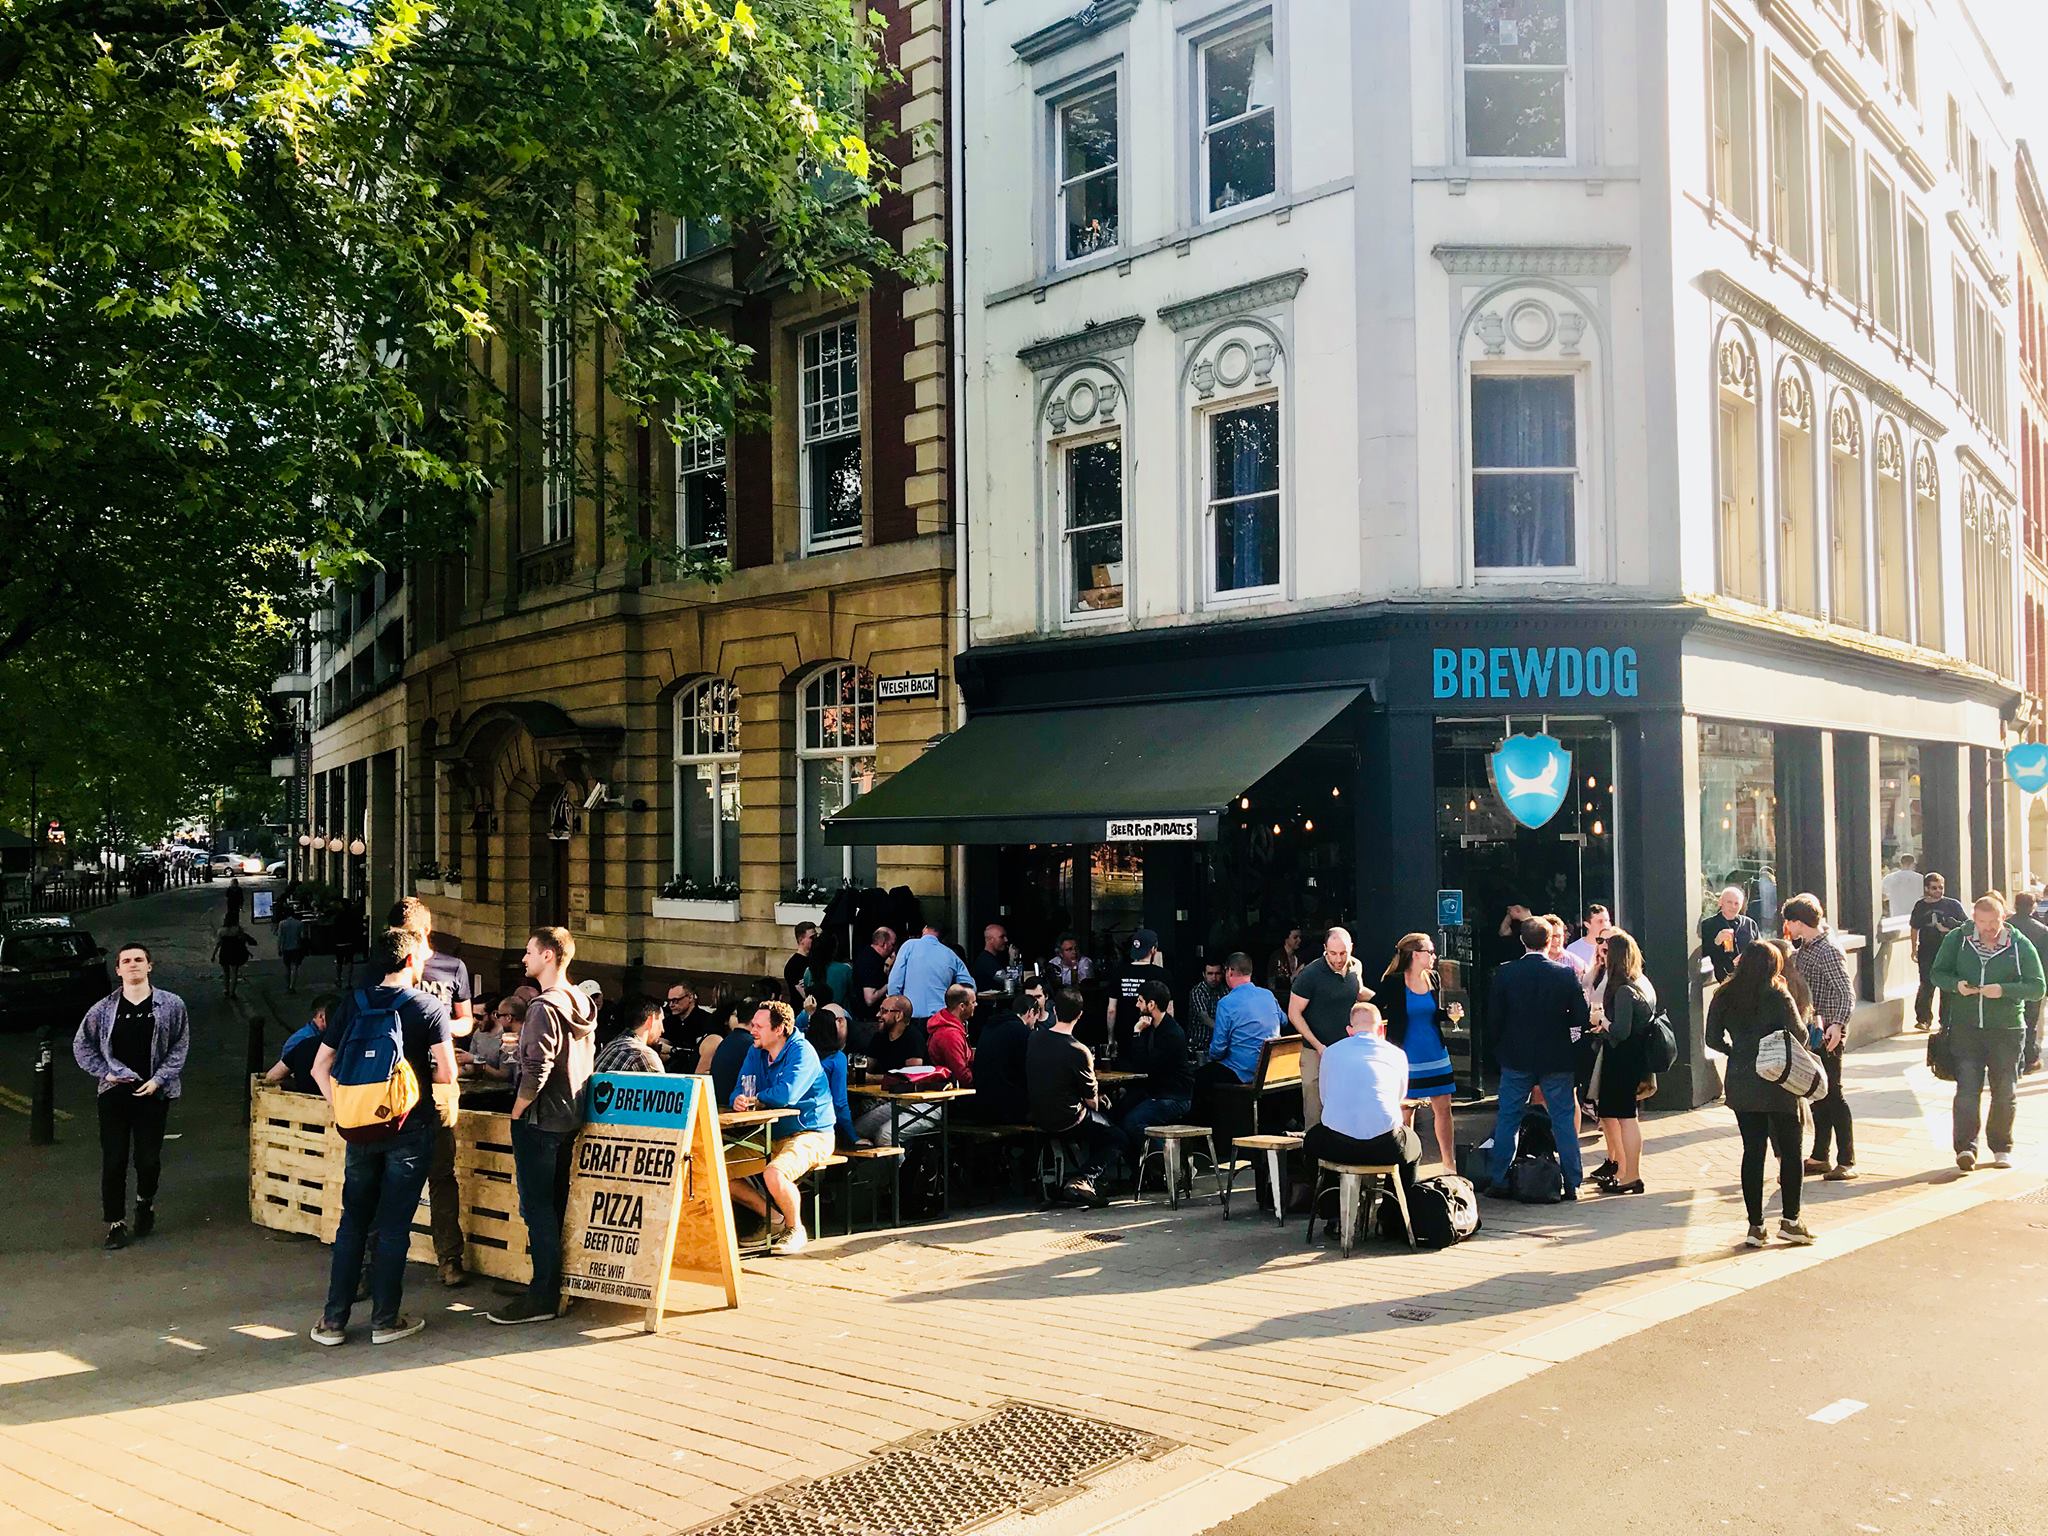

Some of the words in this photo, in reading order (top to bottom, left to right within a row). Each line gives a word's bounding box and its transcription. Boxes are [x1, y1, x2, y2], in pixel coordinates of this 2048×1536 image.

[1433, 646, 1638, 699] BREWDOG
[881, 681, 909, 694] WELSH
[911, 679, 934, 692] BACK
[1111, 823, 1134, 836] BEER
[1153, 822, 1193, 836] PIRATES
[614, 1087, 685, 1115] BREWDOG
[579, 1142, 633, 1174] CRAFT
[633, 1146, 676, 1178] BEER
[590, 1191, 643, 1229] PIZZA
[584, 1231, 610, 1252] BEER
[611, 1234, 625, 1254] TO
[624, 1236, 640, 1256] GO
[589, 1261, 608, 1277] FREE
[607, 1264, 626, 1280] WIFI
[571, 1277, 583, 1290] THE
[582, 1279, 601, 1293] CRAFT
[600, 1282, 616, 1295] BEER
